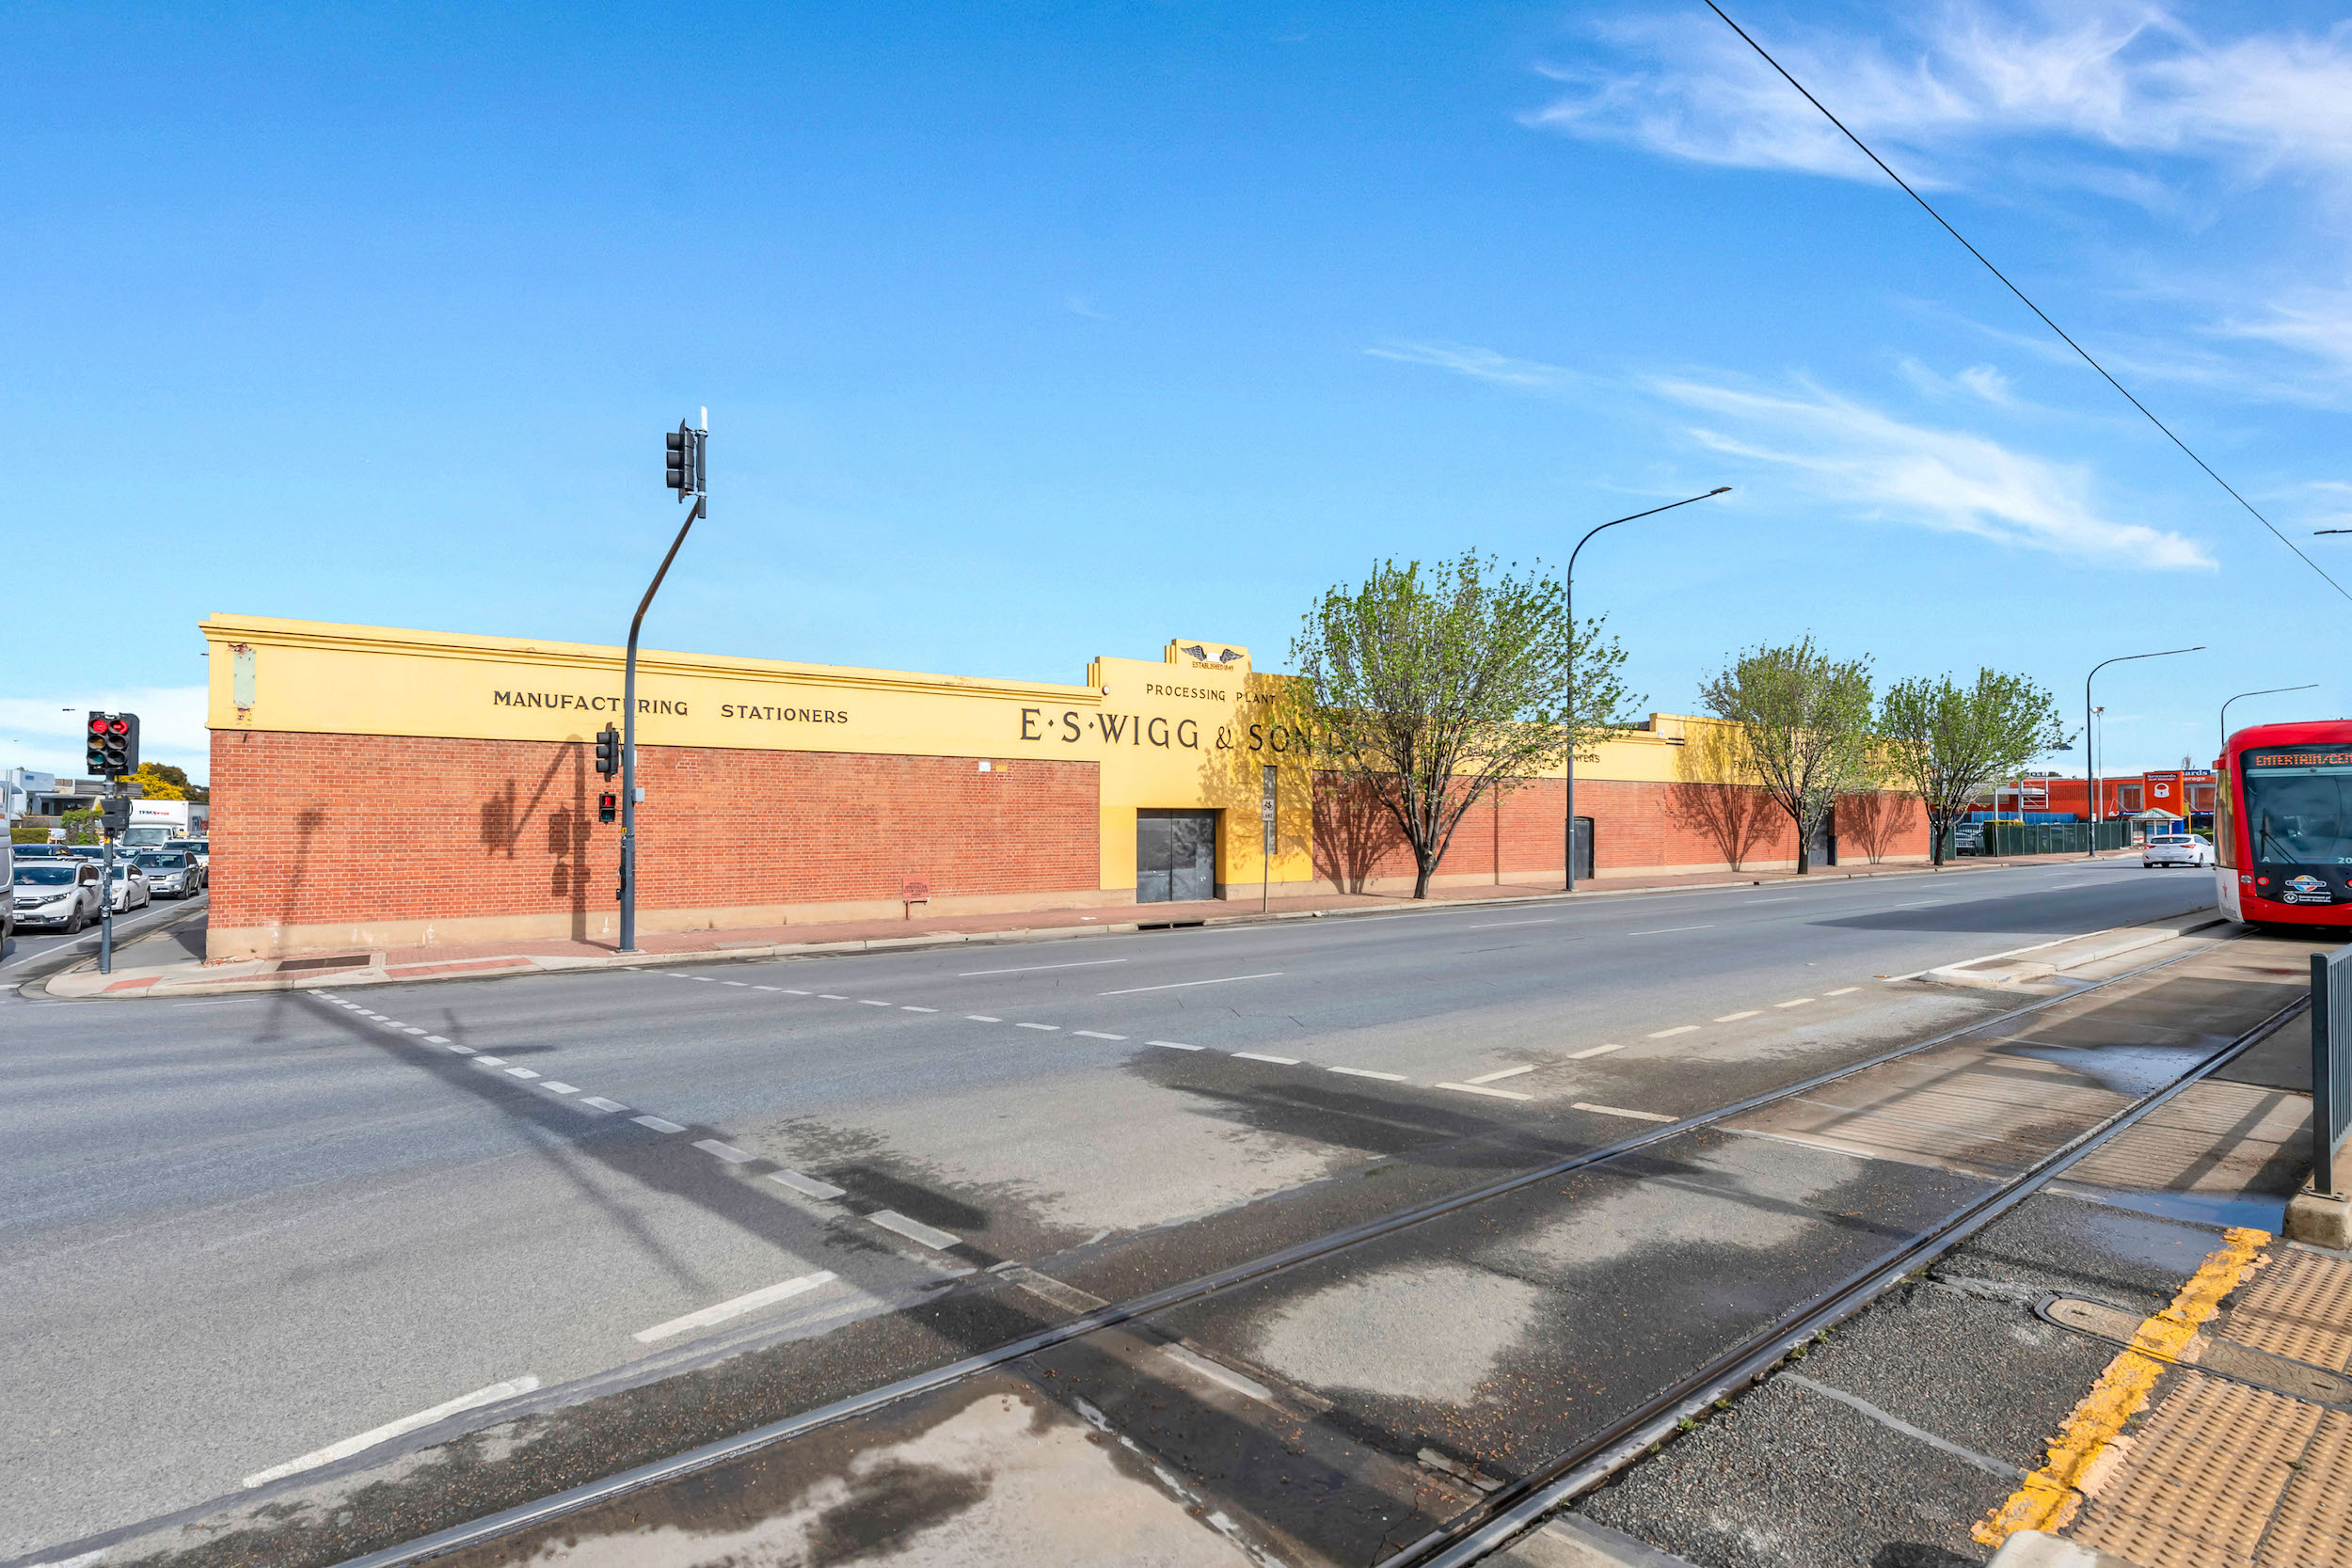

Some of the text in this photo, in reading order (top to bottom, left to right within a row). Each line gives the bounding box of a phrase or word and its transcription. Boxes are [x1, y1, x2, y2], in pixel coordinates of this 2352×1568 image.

[1192, 661, 1223, 671] ESTABLISHED
[1146, 684, 1276, 705] PROCESSING PLANT
[494, 690, 849, 724] MANUFACTRING STATIONERS
[1216, 725, 1233, 750] &
